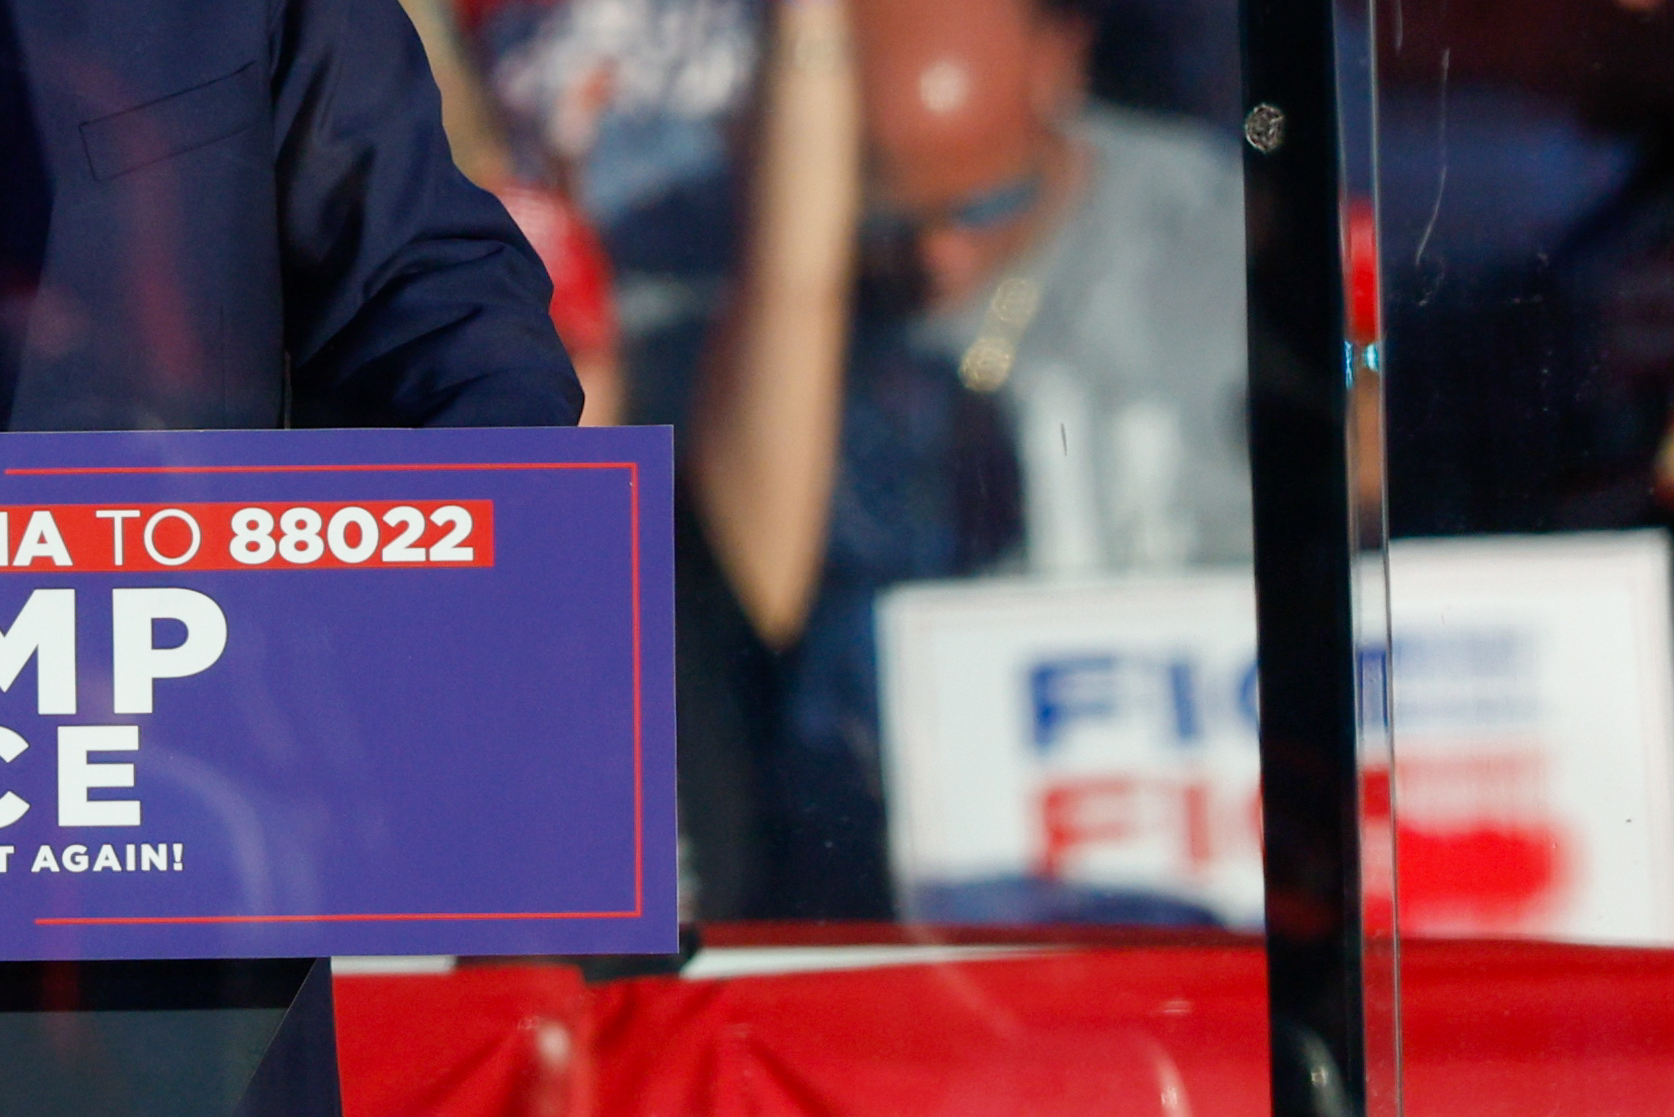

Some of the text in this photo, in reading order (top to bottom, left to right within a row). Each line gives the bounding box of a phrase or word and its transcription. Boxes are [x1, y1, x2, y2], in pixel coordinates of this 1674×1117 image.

[95, 507, 202, 567] TO
[229, 504, 475, 566] 88022
[30, 842, 184, 874] AGAIN!
